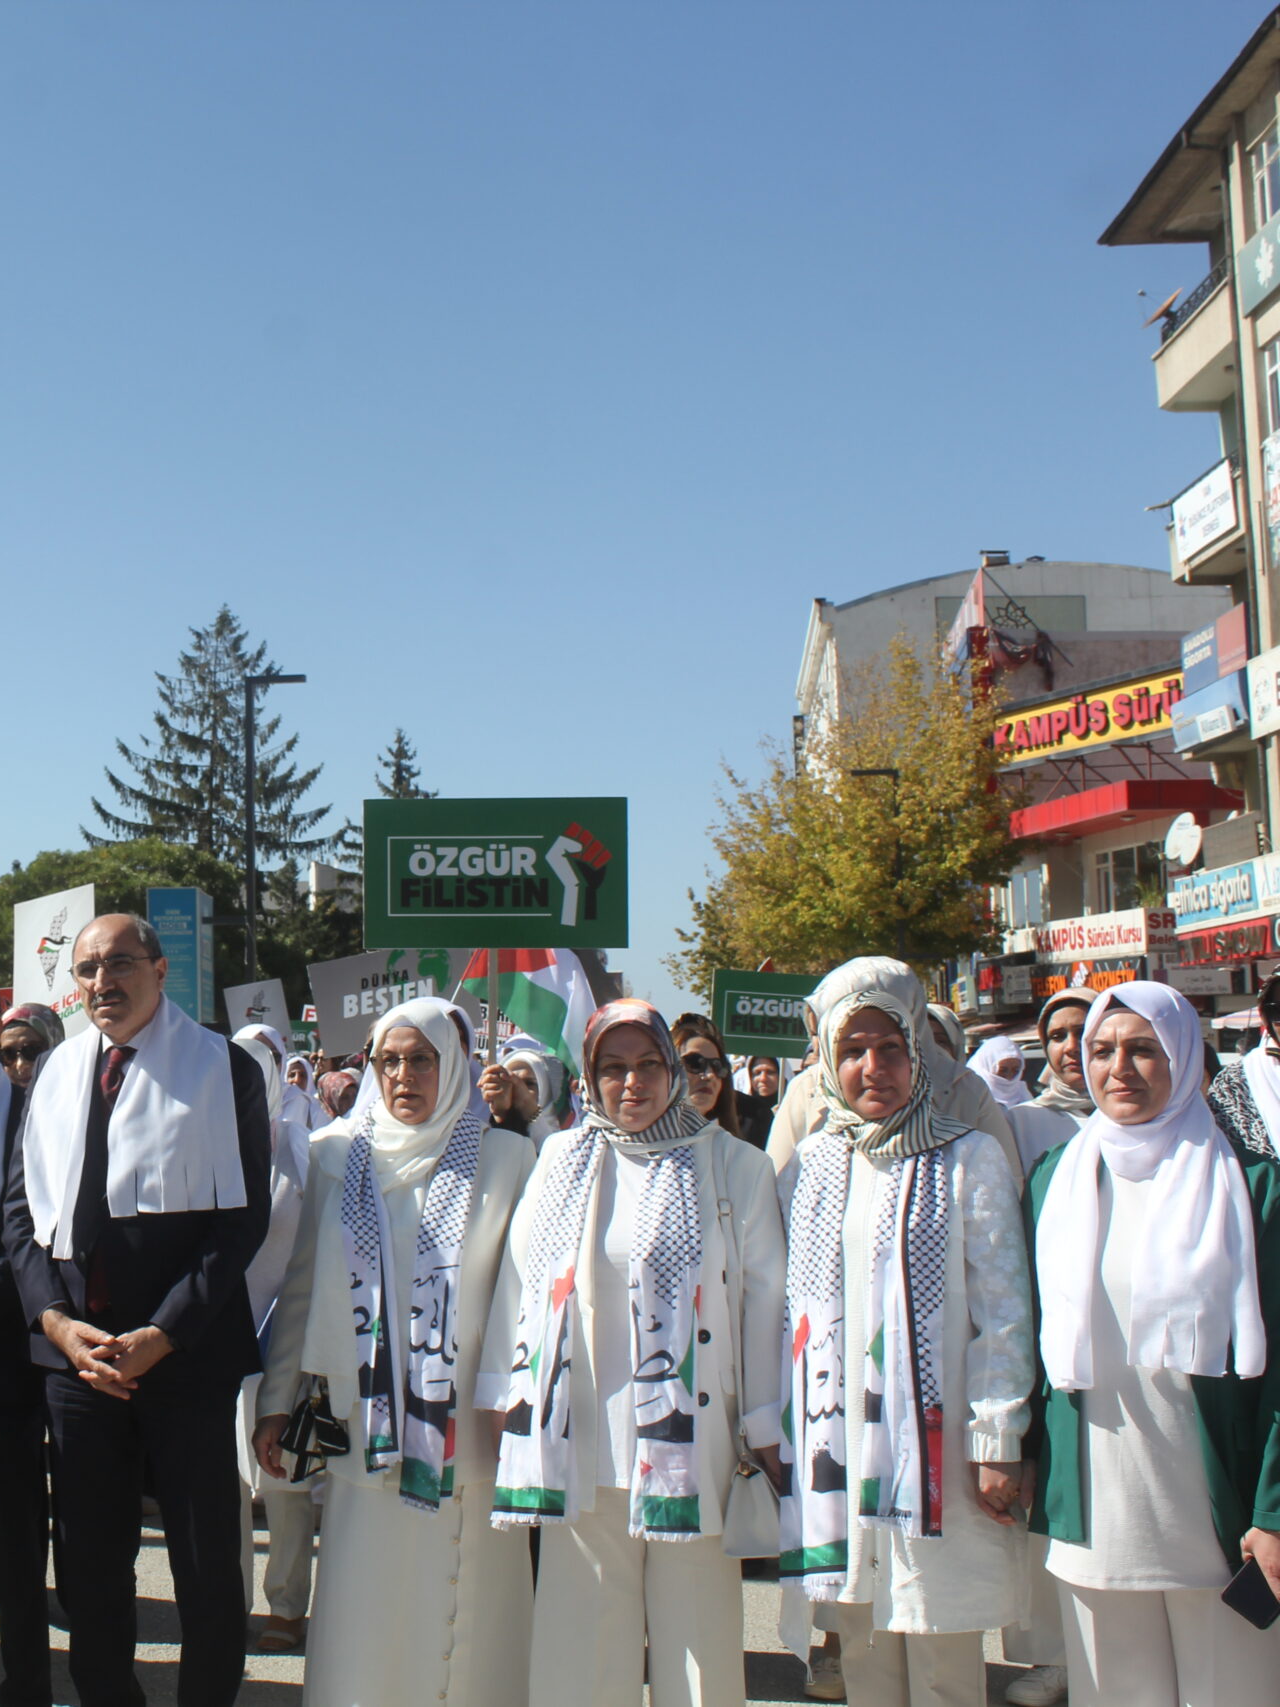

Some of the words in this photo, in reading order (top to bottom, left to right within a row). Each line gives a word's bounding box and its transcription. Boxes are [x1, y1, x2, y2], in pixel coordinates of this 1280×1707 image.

[994, 695, 1109, 752] KAMPÜS
[1113, 680, 1182, 727] Sürü
[408, 844, 537, 877] ÖZGÜR
[1210, 868, 1252, 915] sigorta
[1036, 920, 1085, 953] KAMPÜS
[1117, 925, 1142, 944] Kursu
[1148, 913, 1176, 930] SR
[361, 969, 410, 990] DÜNYA
[736, 996, 805, 1018] ÖZGÜR
